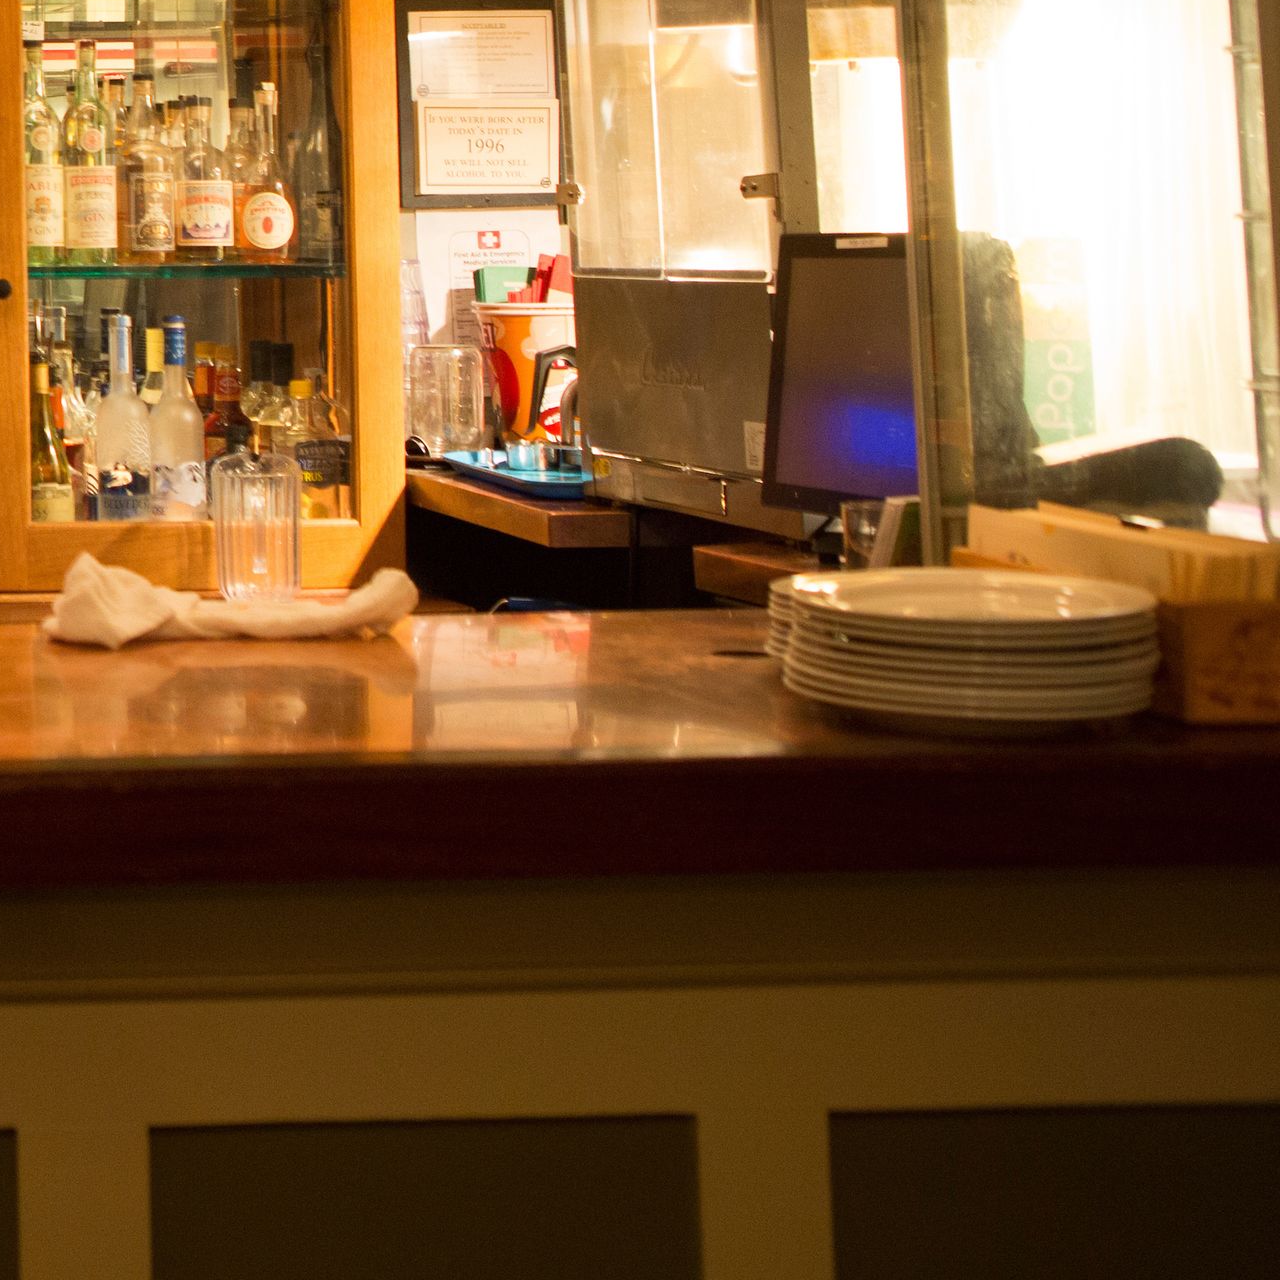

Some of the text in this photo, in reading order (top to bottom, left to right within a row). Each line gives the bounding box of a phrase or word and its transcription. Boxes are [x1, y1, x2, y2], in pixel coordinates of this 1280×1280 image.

[438, 115, 455, 124] YOU
[460, 115, 483, 124] WERE
[488, 115, 514, 124] BORN
[517, 115, 545, 124] AFTER
[487, 127, 510, 135] DATE
[467, 138, 505, 153] 1996
